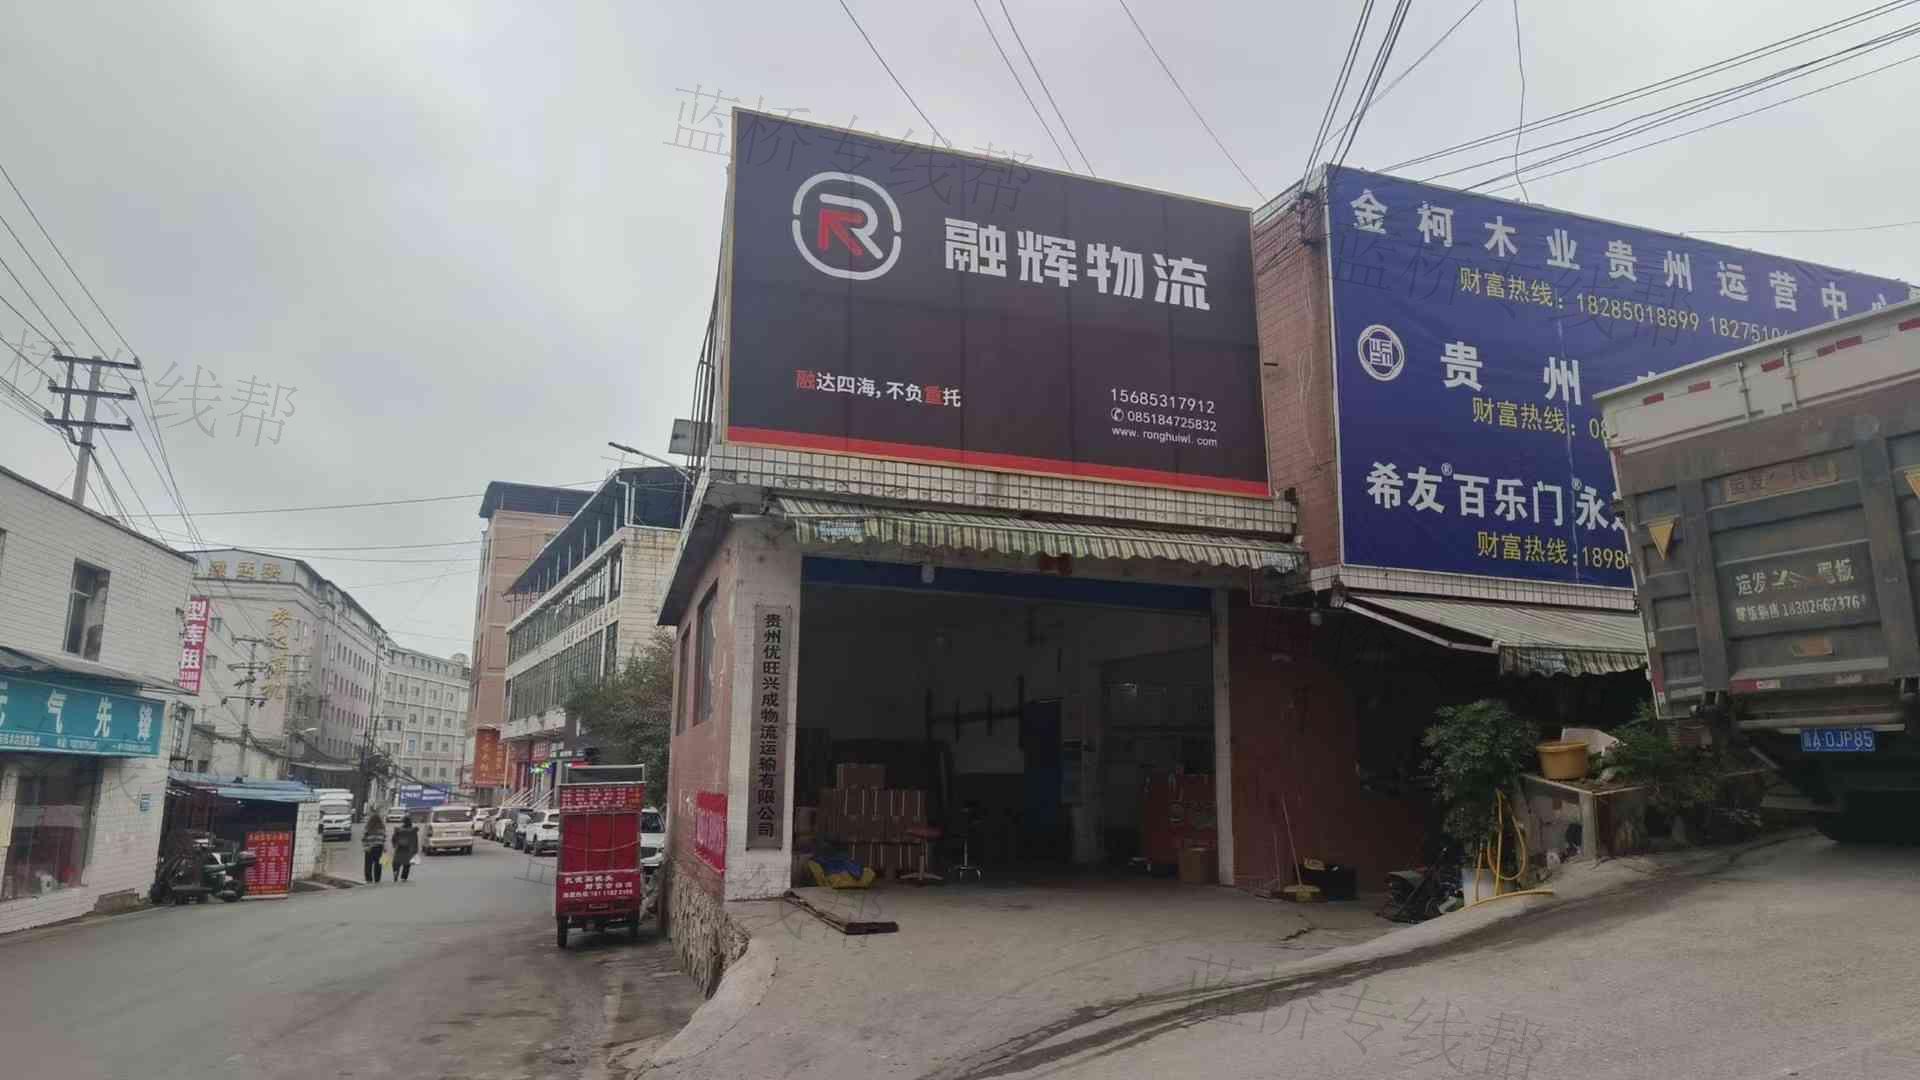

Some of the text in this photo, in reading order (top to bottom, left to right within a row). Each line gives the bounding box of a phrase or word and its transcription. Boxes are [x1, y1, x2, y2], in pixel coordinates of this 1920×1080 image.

[944, 216, 1211, 311] 融辉物流
[1710, 315, 1792, 346] 1827510
[1110, 387, 1216, 415] 15685317912
[1127, 409, 1217, 433] 085184725832
[1582, 546, 1632, 570] 1898
[756, 613, 782, 838] 贵州优旺兴成物流运输有限公司
